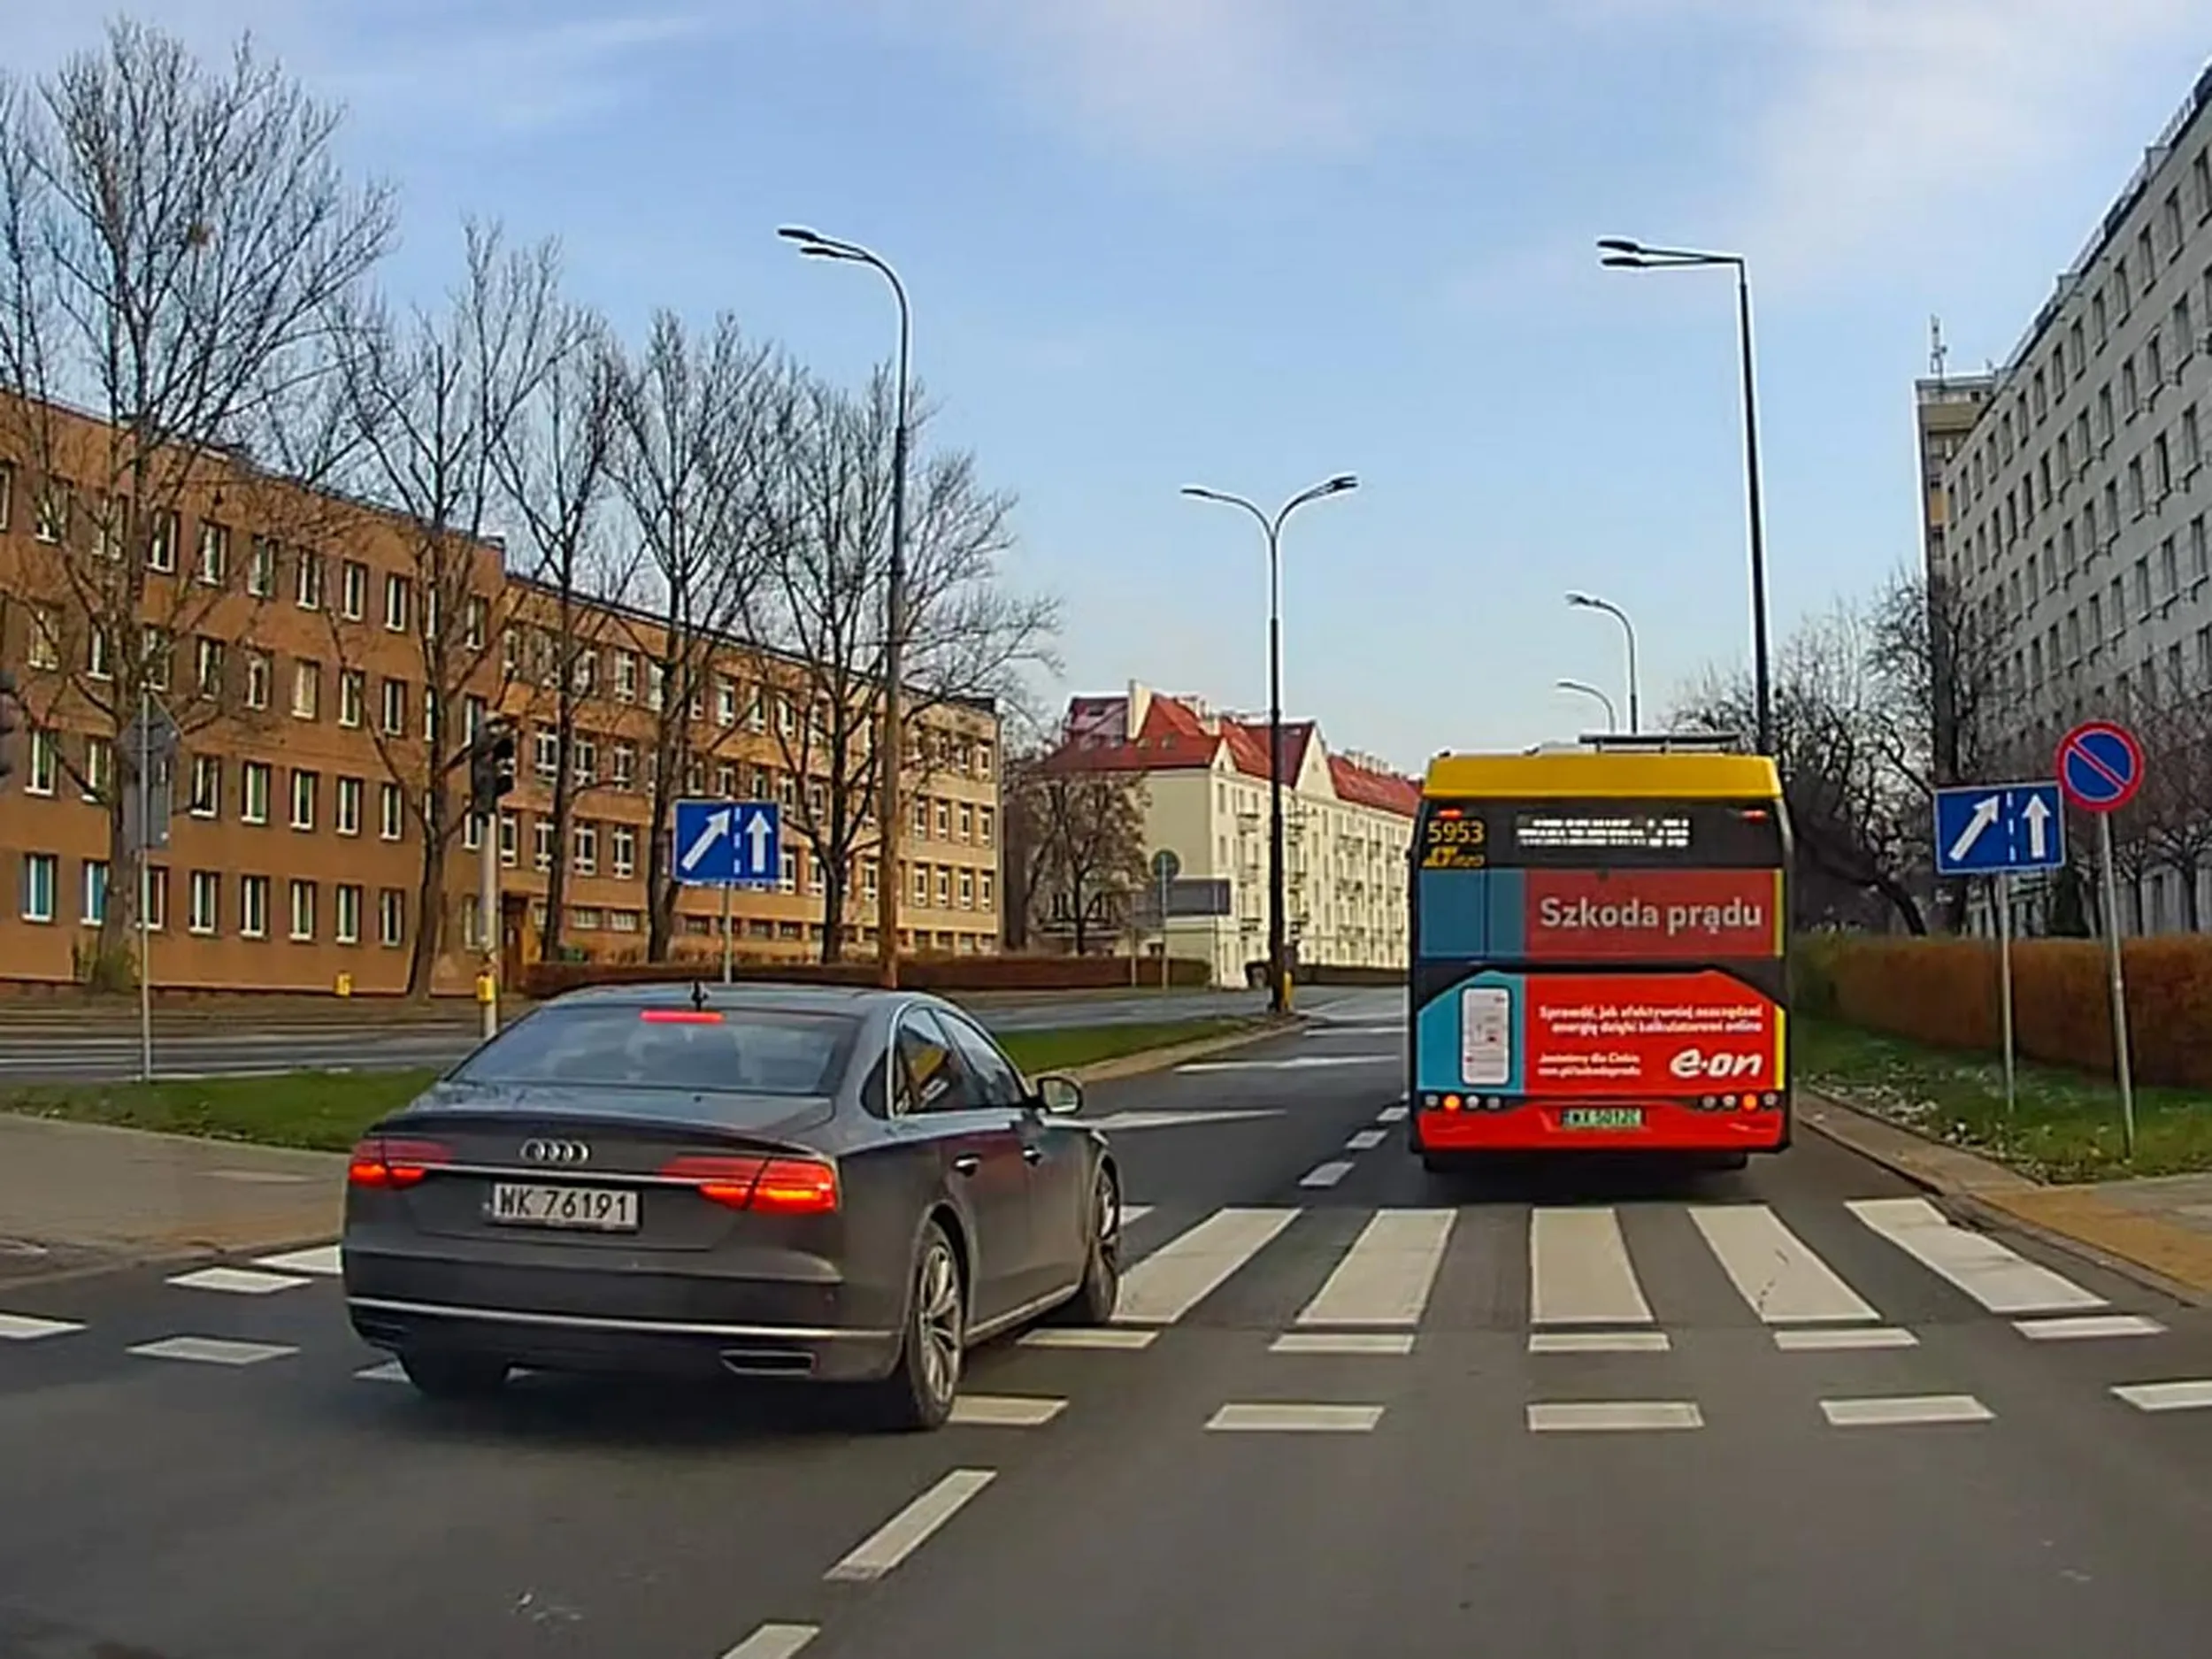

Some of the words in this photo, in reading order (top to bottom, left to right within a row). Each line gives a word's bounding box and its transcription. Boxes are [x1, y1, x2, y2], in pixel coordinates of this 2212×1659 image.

[1427, 819, 1485, 843] 5953
[1540, 895, 1659, 928] Szkoda
[1666, 895, 1763, 936] prądu
[501, 1187, 533, 1215] WK
[543, 1190, 626, 1222] 76191
